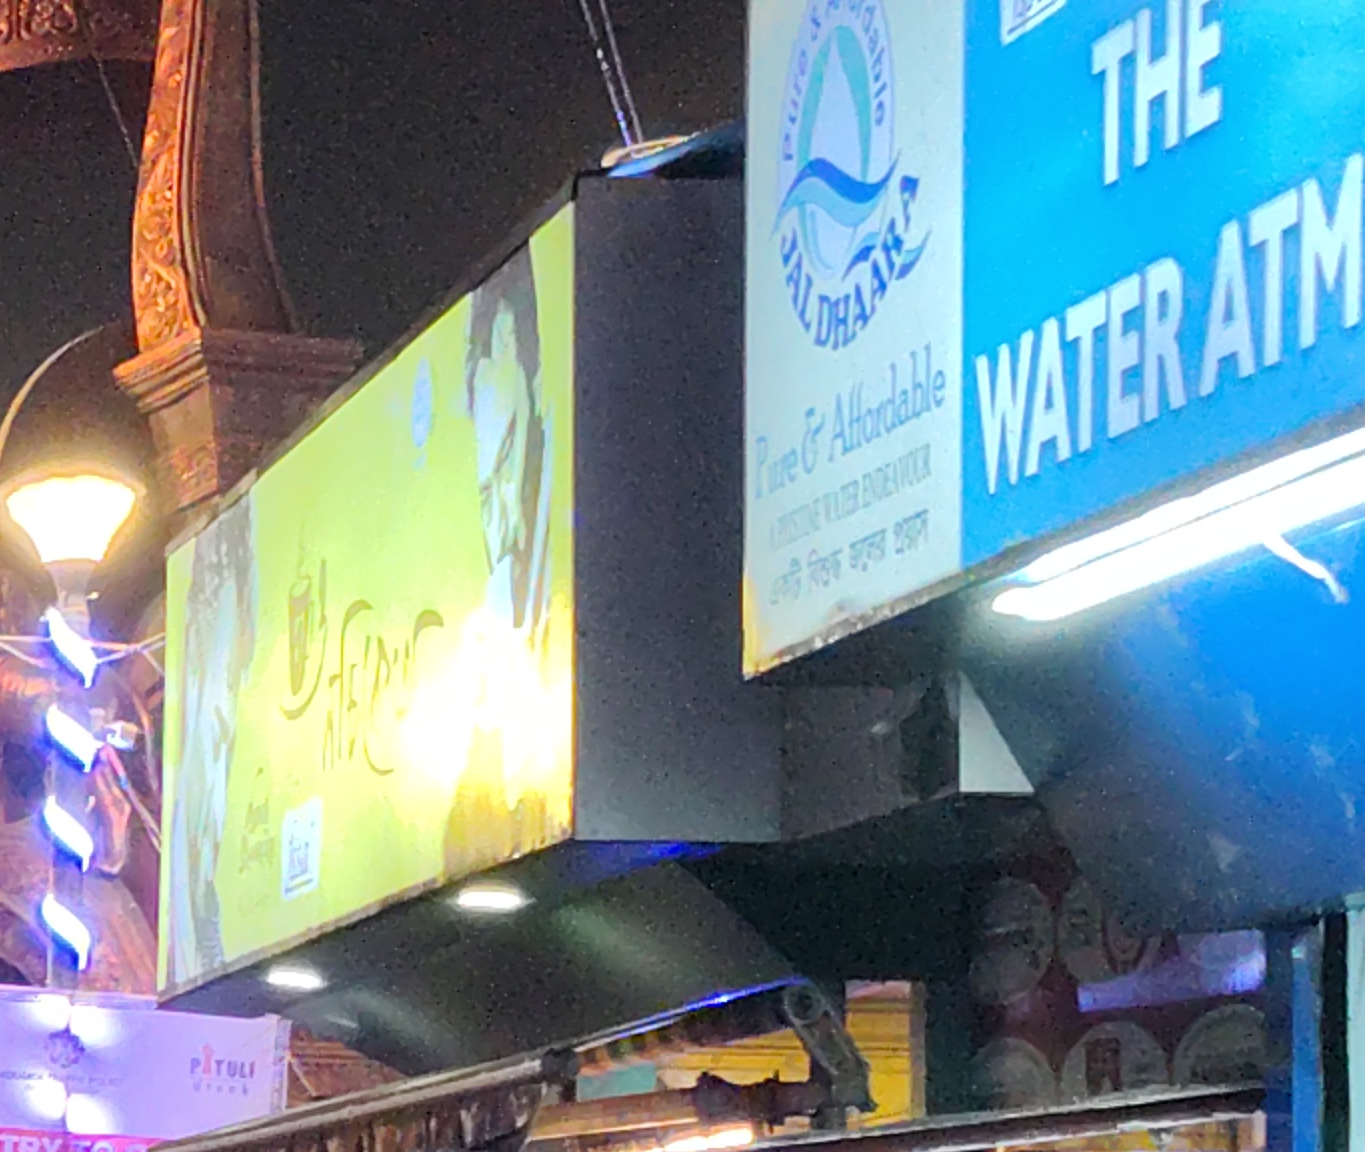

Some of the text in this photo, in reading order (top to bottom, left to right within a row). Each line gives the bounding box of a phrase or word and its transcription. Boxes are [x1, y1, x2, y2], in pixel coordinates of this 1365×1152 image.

[1091, 0, 1223, 186] THE
[975, 153, 1365, 495] WATER ATM
[755, 435, 798, 500] Pure
[827, 340, 946, 462] Affordable
